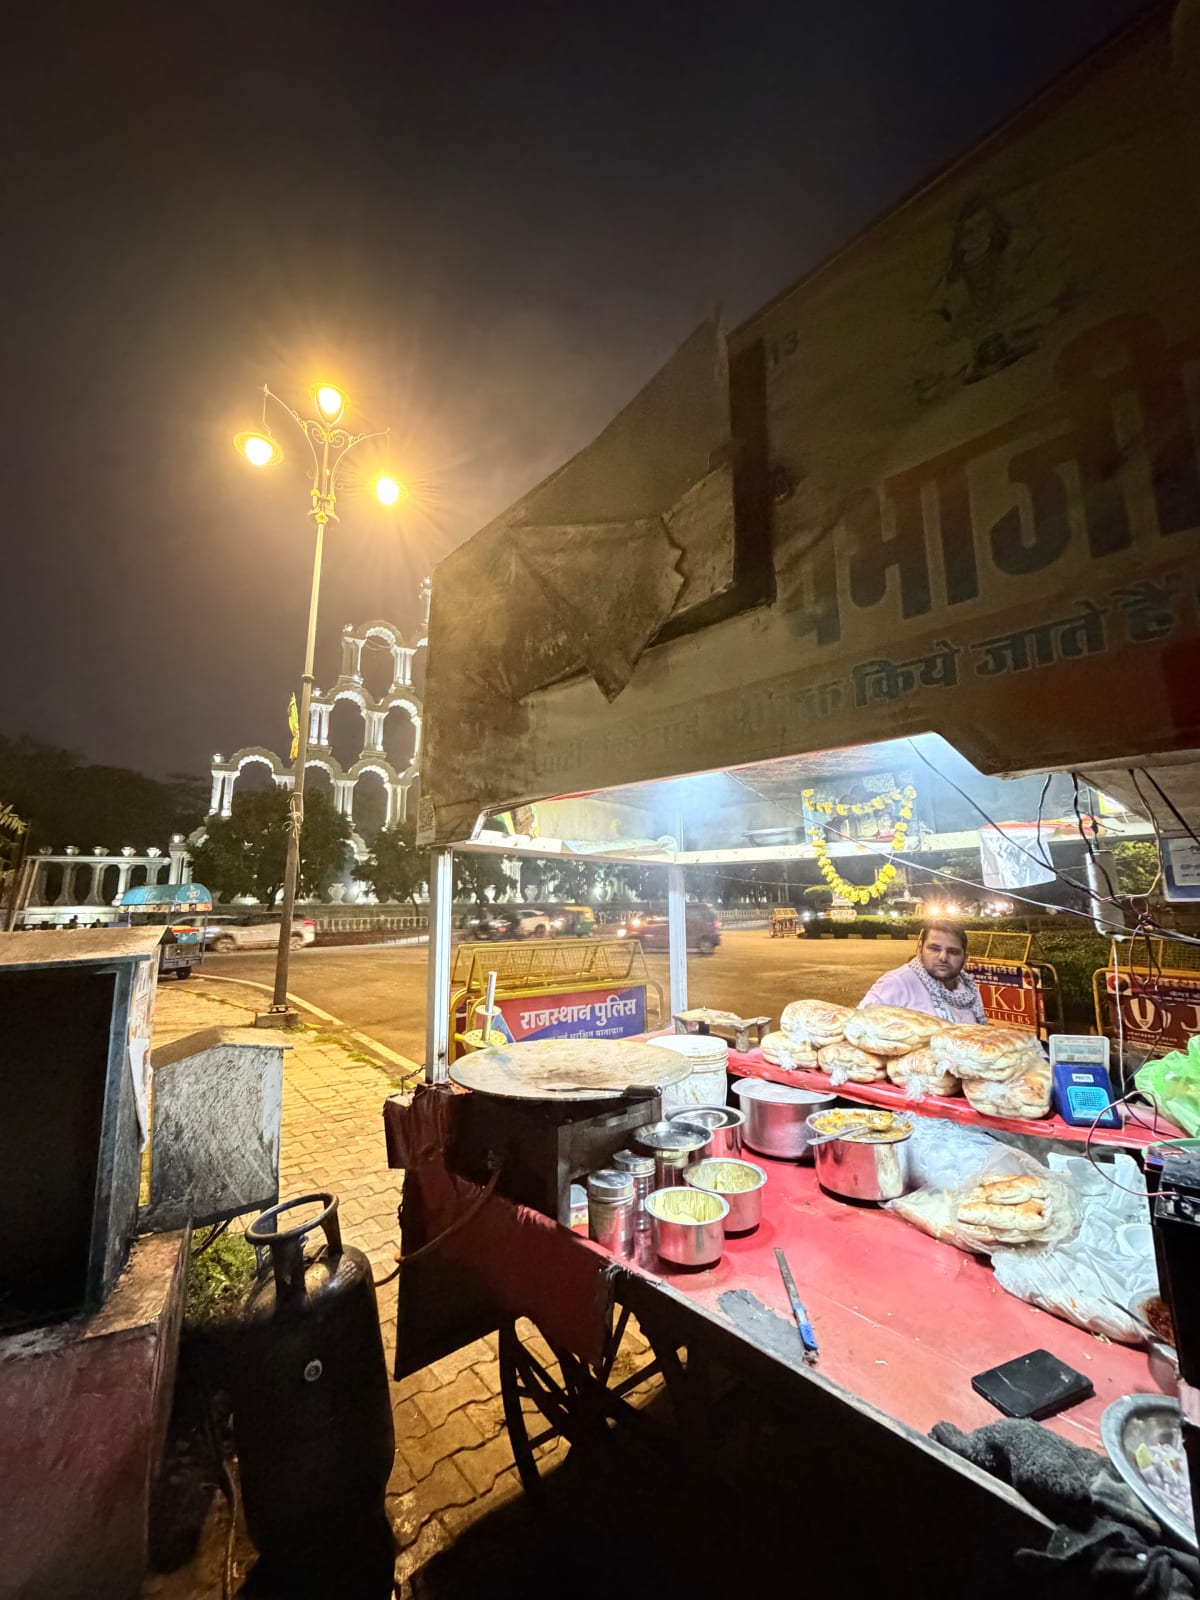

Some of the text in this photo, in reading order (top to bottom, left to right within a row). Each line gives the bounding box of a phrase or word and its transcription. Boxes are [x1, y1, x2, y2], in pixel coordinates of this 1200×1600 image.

[852, 639, 962, 709] किये
[968, 599, 1108, 679] जाते
[520, 994, 637, 1029] राजस्थान पुलिस
